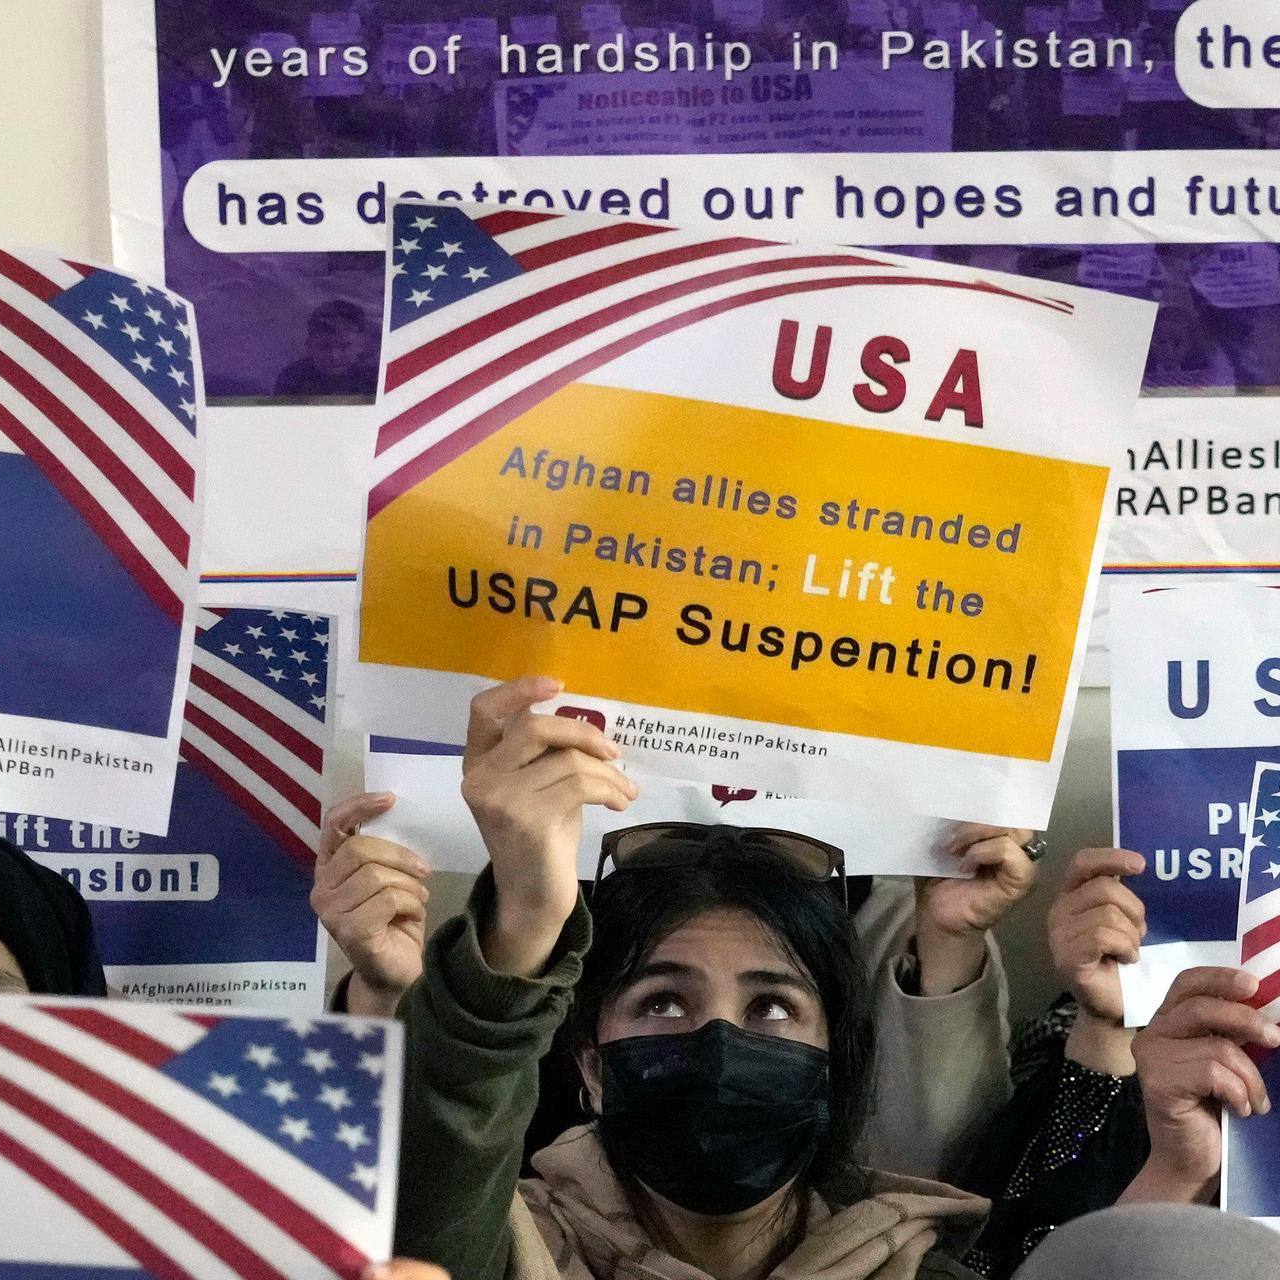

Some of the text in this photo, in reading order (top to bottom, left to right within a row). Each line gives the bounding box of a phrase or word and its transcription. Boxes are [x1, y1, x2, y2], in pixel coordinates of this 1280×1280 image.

[210, 46, 370, 88] years
[408, 35, 462, 76] of
[499, 33, 753, 82] hardship
[792, 32, 839, 72] in
[880, 29, 1155, 76] Pakistan,
[750, 73, 814, 104] USA
[218, 183, 325, 226] has
[702, 181, 805, 221] our
[834, 174, 1023, 229] hopes
[1054, 176, 1156, 218] and
[770, 317, 985, 429] USA
[499, 445, 1022, 555] Afghan allies stranded
[507, 515, 985, 618] in Pakistan; Lift the
[446, 565, 1039, 694] USRAP Suspention!
[611, 732, 741, 761] #LiftUSRAPBan
[615, 714, 829, 758] #AfghanAlliesInPakistan
[122, 978, 308, 998] #AfghanAlliesInPakistan
